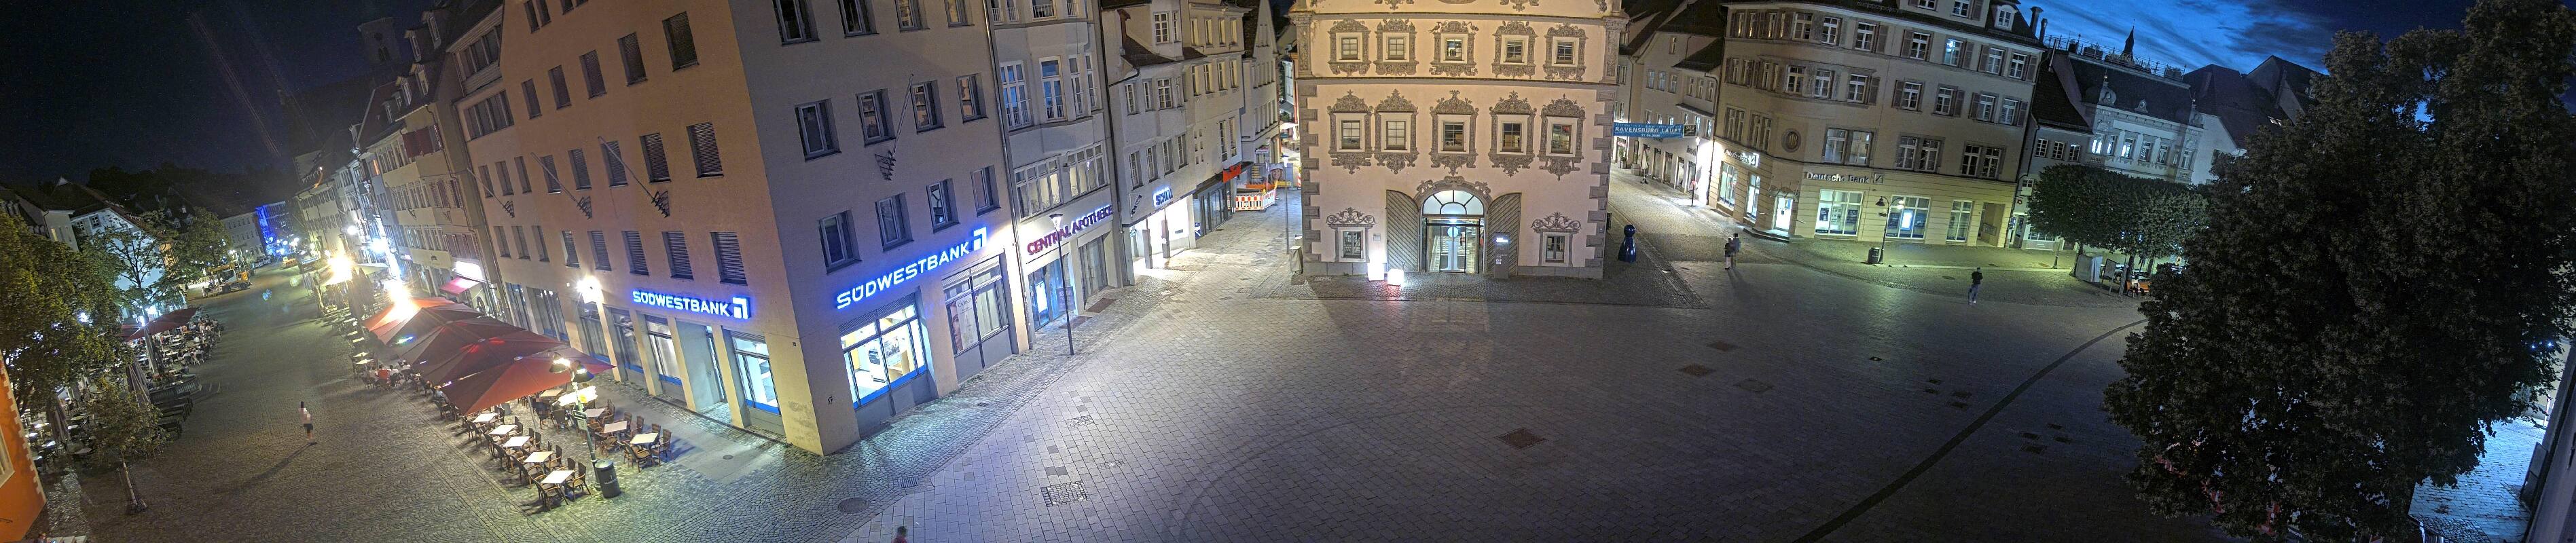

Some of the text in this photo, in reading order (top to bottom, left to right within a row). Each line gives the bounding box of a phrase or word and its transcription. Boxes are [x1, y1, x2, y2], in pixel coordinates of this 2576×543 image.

[1807, 172, 1870, 183] Deutsche Bank
[1027, 205, 1113, 255] CENTRAL APOTHEKE
[837, 241, 970, 310] SÜDWESTBANK
[632, 291, 731, 317] SÜDWESTBANK
